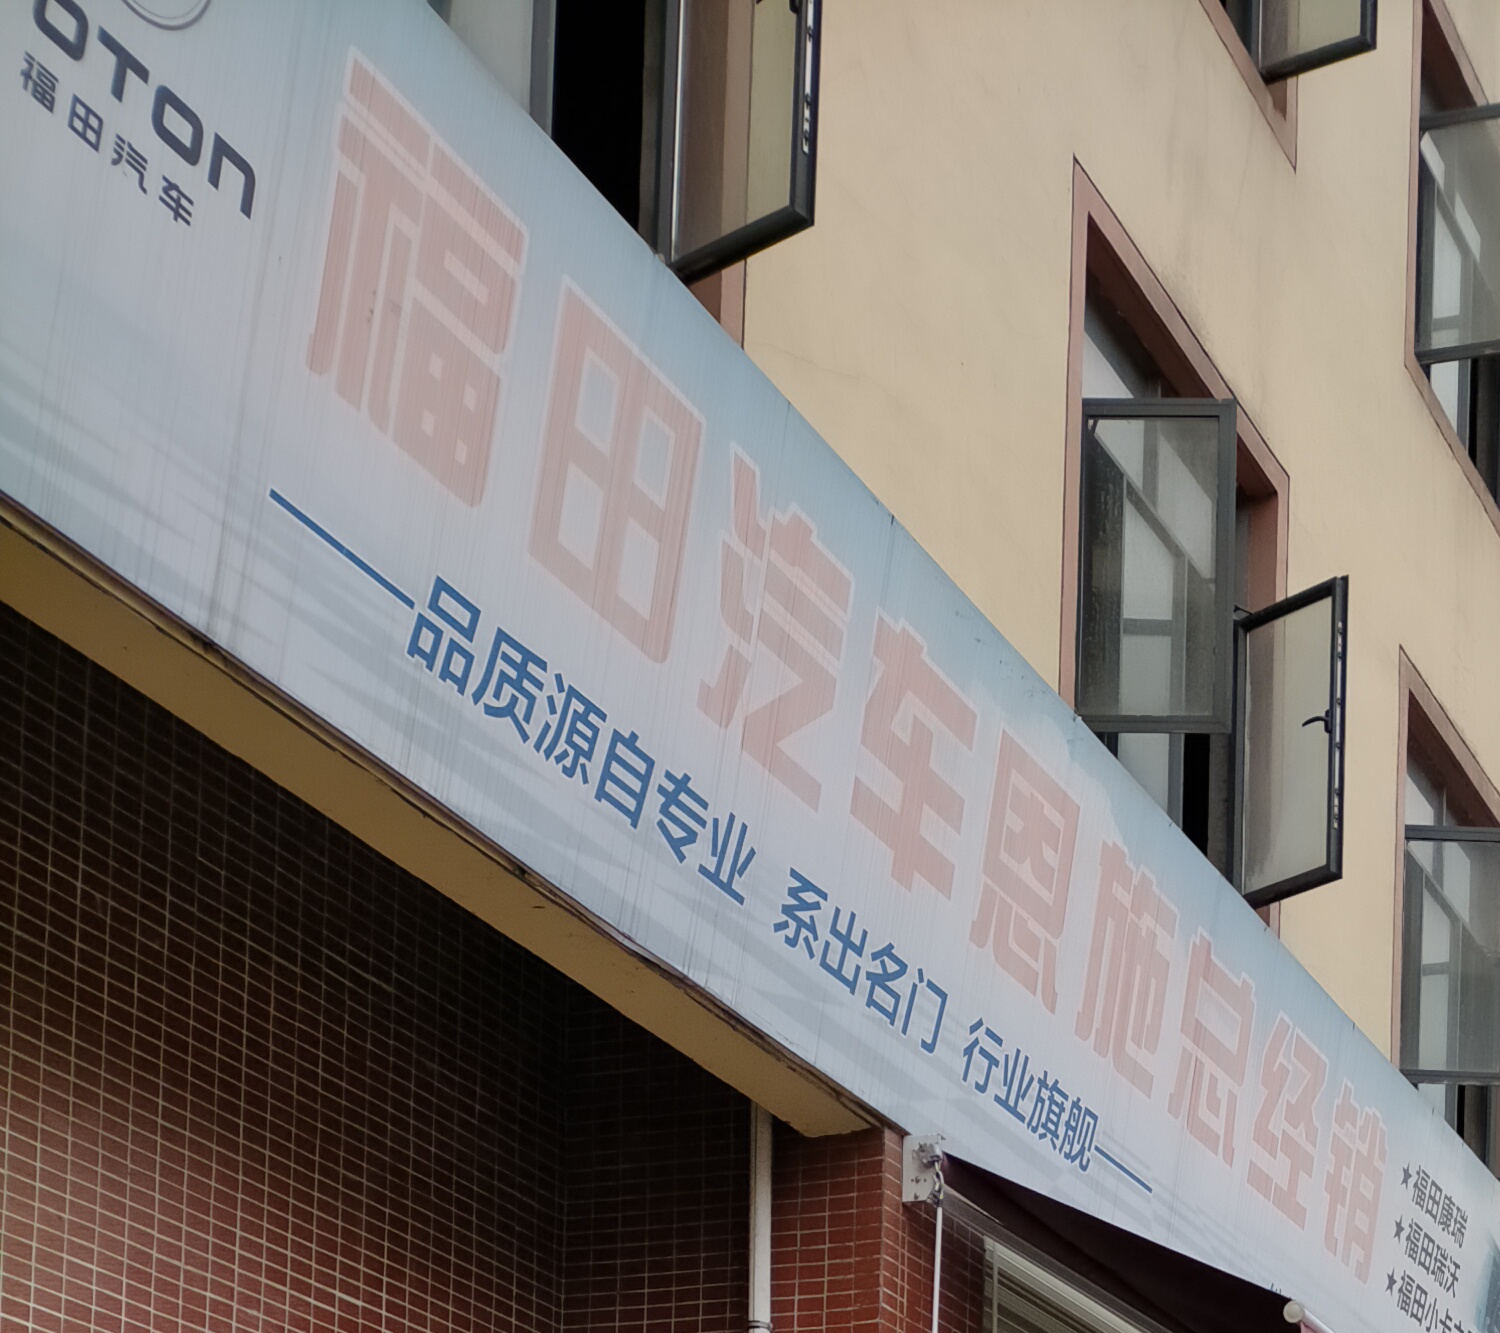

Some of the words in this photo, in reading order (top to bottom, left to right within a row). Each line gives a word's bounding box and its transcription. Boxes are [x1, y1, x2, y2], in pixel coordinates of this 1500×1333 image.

[19, 51, 195, 227] 福田汽车
[306, 48, 1387, 1284] 福田汽车恩施总经销
[406, 575, 757, 905] 品质源自专业
[773, 867, 948, 1054] 系出名门
[961, 1017, 1098, 1173] 行业旗舰
[1404, 1217, 1461, 1298] 福田瑞沃
[1411, 1165, 1469, 1248] 福田康瑞
